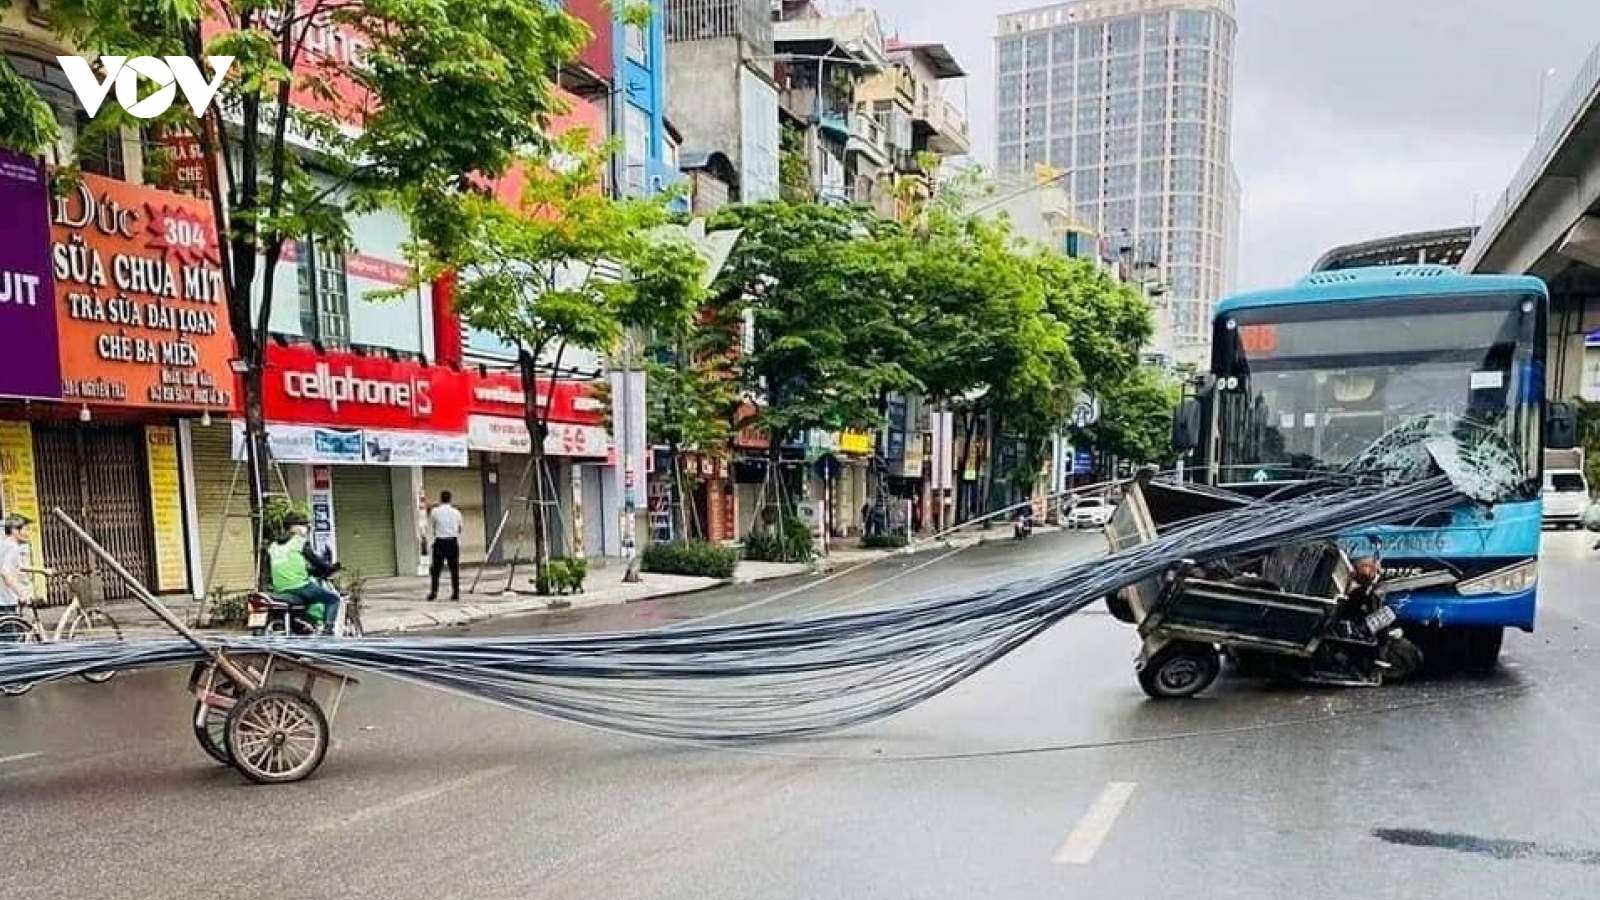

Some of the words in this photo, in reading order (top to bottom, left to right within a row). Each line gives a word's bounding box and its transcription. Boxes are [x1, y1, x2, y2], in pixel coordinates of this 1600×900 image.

[163, 217, 207, 249] 304
[183, 261, 222, 303] MÍT
[69, 288, 105, 321] TRÀ
[148, 300, 176, 330] ĐÀI
[180, 308, 218, 335] LOAN
[98, 331, 133, 361] CHÈ
[136, 338, 158, 363] BA
[162, 333, 199, 367] MIỀN
